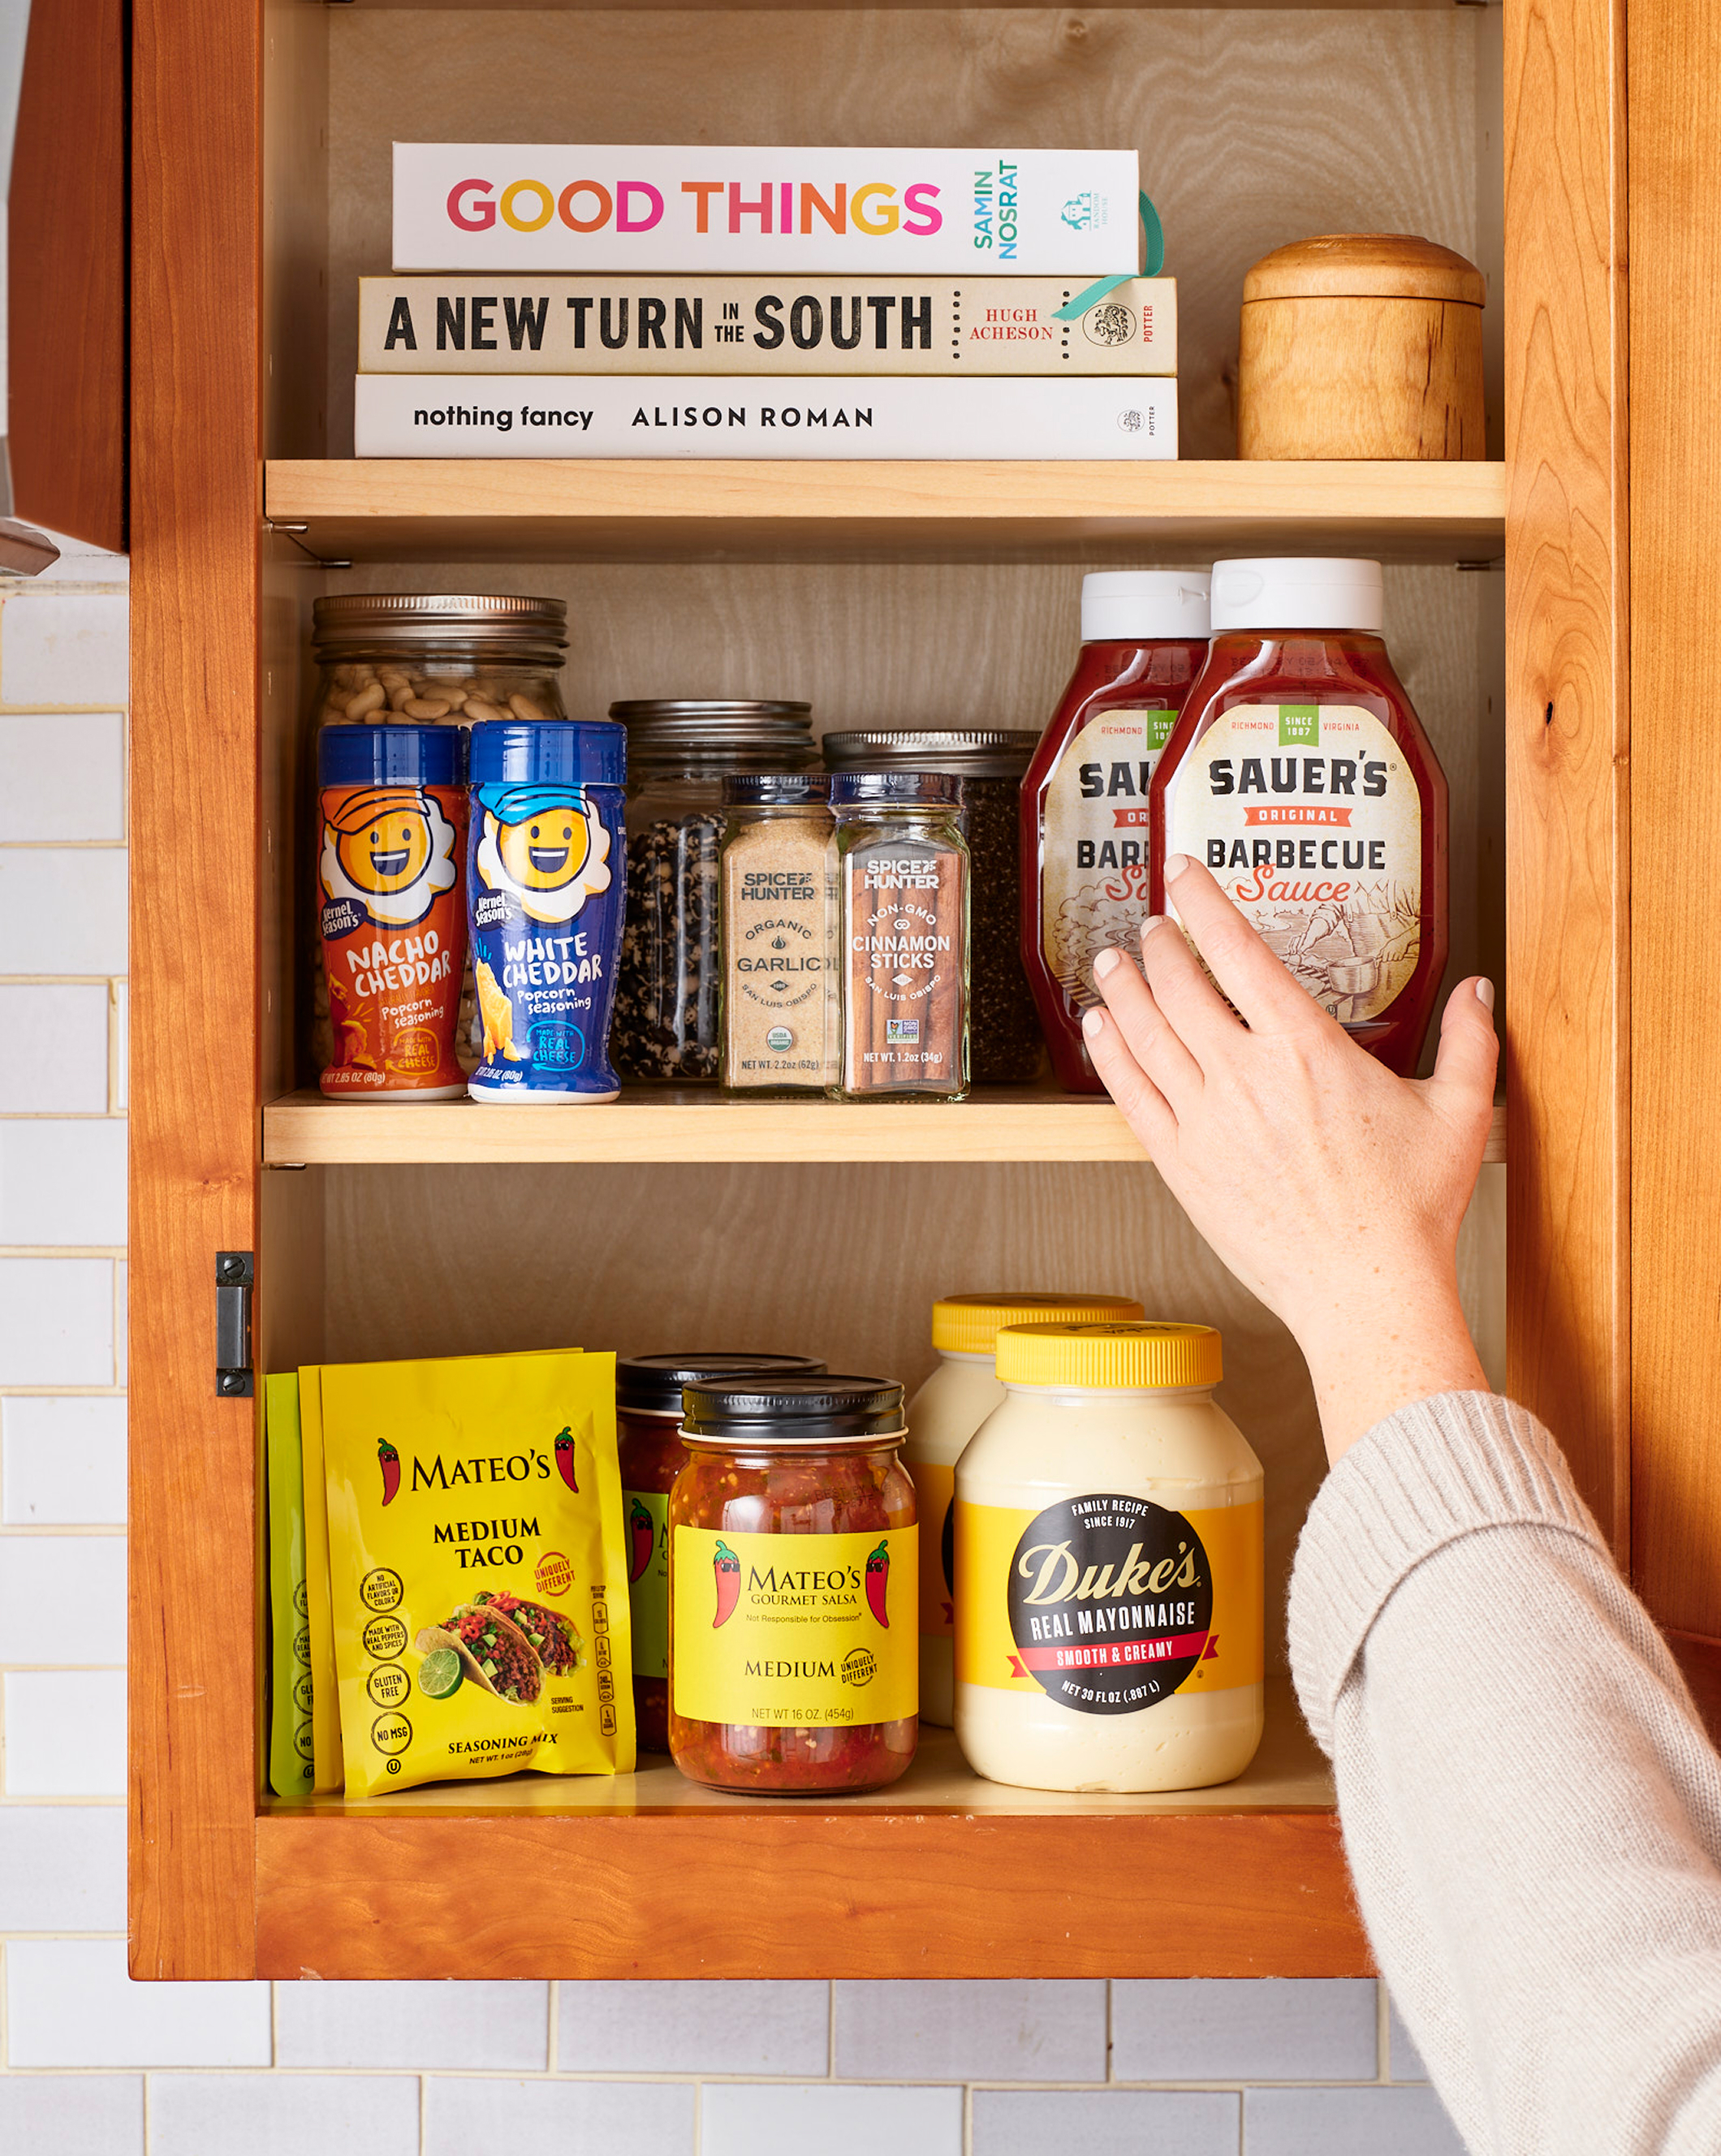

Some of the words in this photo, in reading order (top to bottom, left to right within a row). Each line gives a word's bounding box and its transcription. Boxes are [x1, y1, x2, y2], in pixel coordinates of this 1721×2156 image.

[446, 178, 664, 233] GOOD
[681, 181, 943, 235] THINGS
[973, 170, 993, 249] SAMIN
[999, 160, 1018, 259] NOSRAT
[722, 303, 739, 320] IN
[986, 308, 1037, 323] HUGH
[384, 296, 417, 350] A
[436, 296, 550, 351] NEW
[567, 297, 703, 350] TURN
[753, 295, 932, 350] SOUTH
[1143, 305, 1153, 343] POTTER
[714, 325, 744, 343] THE
[969, 326, 1054, 341] ACHESON
[414, 406, 513, 431] nothing
[520, 406, 594, 430] fancy
[632, 407, 746, 427] ALISON
[761, 407, 873, 428] ROMAN
[1231, 721, 1275, 731] RICHMOND
[1285, 716, 1313, 726] SINCE
[1323, 722, 1360, 731] VIRGINIA
[1101, 727, 1142, 735] RICHMOND
[1288, 727, 1310, 736] 1887
[1208, 750, 1388, 797] SAUER'S
[1259, 809, 1337, 821] ORIGINAL
[1207, 839, 1386, 869] BARBECUE
[867, 860, 922, 874] SPICE
[744, 873, 798, 886] SPICE
[864, 874, 939, 889] HUNTER
[1236, 863, 1351, 902] Sauce
[741, 887, 815, 900] HUNTER
[475, 905, 513, 927] Season's
[867, 903, 937, 927] NON-GMO
[745, 919, 812, 940] ORGANIC
[346, 930, 439, 973] NACHO
[504, 932, 588, 964] WHITE
[852, 935, 950, 952] CINNAMON
[737, 957, 821, 972] GARLIC
[870, 953, 934, 969] STICKS
[355, 950, 451, 998] CHEDDAR
[502, 954, 602, 988] CHEDDAR
[742, 984, 759, 1002] SAN
[761, 998, 783, 1008] LUIS
[786, 982, 817, 1007] OBISPO
[865, 976, 882, 994] SAN
[883, 990, 907, 1001] LUIS
[909, 974, 942, 1000] OBISPO
[517, 988, 576, 1004] Popcorn
[382, 998, 433, 1020] Popcorn
[528, 996, 592, 1015] seasoning
[395, 1006, 444, 1029] seasoning
[399, 1037, 416, 1045] MADE
[539, 1036, 570, 1050] REAL
[404, 1044, 430, 1057] REAL
[533, 1050, 576, 1063] CHEESE
[863, 1052, 879, 1063] NET
[880, 1052, 895, 1063] WT.
[897, 1052, 919, 1063] 1.2oz
[921, 1052, 942, 1063] (34g)
[397, 1055, 436, 1069] CHEESE
[741, 1060, 757, 1070] NET
[759, 1060, 774, 1070] WT.
[774, 1060, 796, 1070] 2.2oz
[798, 1060, 819, 1071] (62g)
[351, 1072, 362, 1084] OZ
[364, 1072, 386, 1084] (80g)
[1071, 1499, 1109, 1517] FAMILY
[1111, 1499, 1149, 1517] RECIPE
[433, 1516, 541, 1544] MEDIUM
[1084, 1516, 1113, 1529] SINCE
[1115, 1516, 1136, 1529] 1917
[455, 1545, 524, 1568] TACO
[534, 1559, 571, 1580] UNIQUELY
[1018, 1540, 1201, 1606] Duke's
[368, 1580, 396, 1592] ARTIFICIAL
[536, 1570, 576, 1593] DIFFERENT
[367, 1589, 390, 1599] FLAVORS
[391, 1587, 399, 1595] OR
[373, 1596, 395, 1606] COLORS
[751, 1593, 817, 1606] GOURMET
[822, 1593, 857, 1605] SALSA
[746, 1614, 760, 1622] Not
[761, 1615, 809, 1623] Responsible
[810, 1615, 821, 1623] for
[1030, 1612, 1073, 1641] REAL
[1077, 1602, 1195, 1634] MAYONNAISE
[366, 1636, 381, 1645] REAL
[381, 1631, 404, 1641] PEPPERS
[369, 1626, 384, 1636] MADE
[384, 1624, 400, 1632] WITH
[371, 1642, 383, 1651] AND
[384, 1639, 403, 1649] SPICES
[1057, 1647, 1107, 1667] SMOOTH
[1111, 1646, 1121, 1662] &
[1124, 1641, 1173, 1661] CREAMY
[744, 1660, 836, 1678] MEDIUM
[840, 1654, 874, 1672] UNIQUELY
[373, 1674, 403, 1688] GLUTEN
[841, 1663, 878, 1684] DIFFERENT
[381, 1686, 399, 1698] FREE
[1061, 1680, 1080, 1697] NET
[1081, 1688, 1093, 1701] 30
[1124, 1686, 1148, 1704] (.887
[1148, 1679, 1161, 1693] L)
[550, 1696, 573, 1705] SERVING
[551, 1705, 584, 1714] SUGGESTION
[752, 1708, 770, 1718] NET
[774, 1709, 789, 1719] WT
[792, 1709, 802, 1719] 16
[805, 1709, 822, 1719] OZ.
[825, 1708, 854, 1721] (454g)
[300, 1736, 312, 1747] NO
[377, 1730, 389, 1742] NO
[390, 1727, 408, 1740] MSG
[448, 1736, 528, 1754] SEASONING
[530, 1733, 559, 1744] MIX
[469, 1756, 485, 1765] NET
[485, 1754, 499, 1762] WT.
